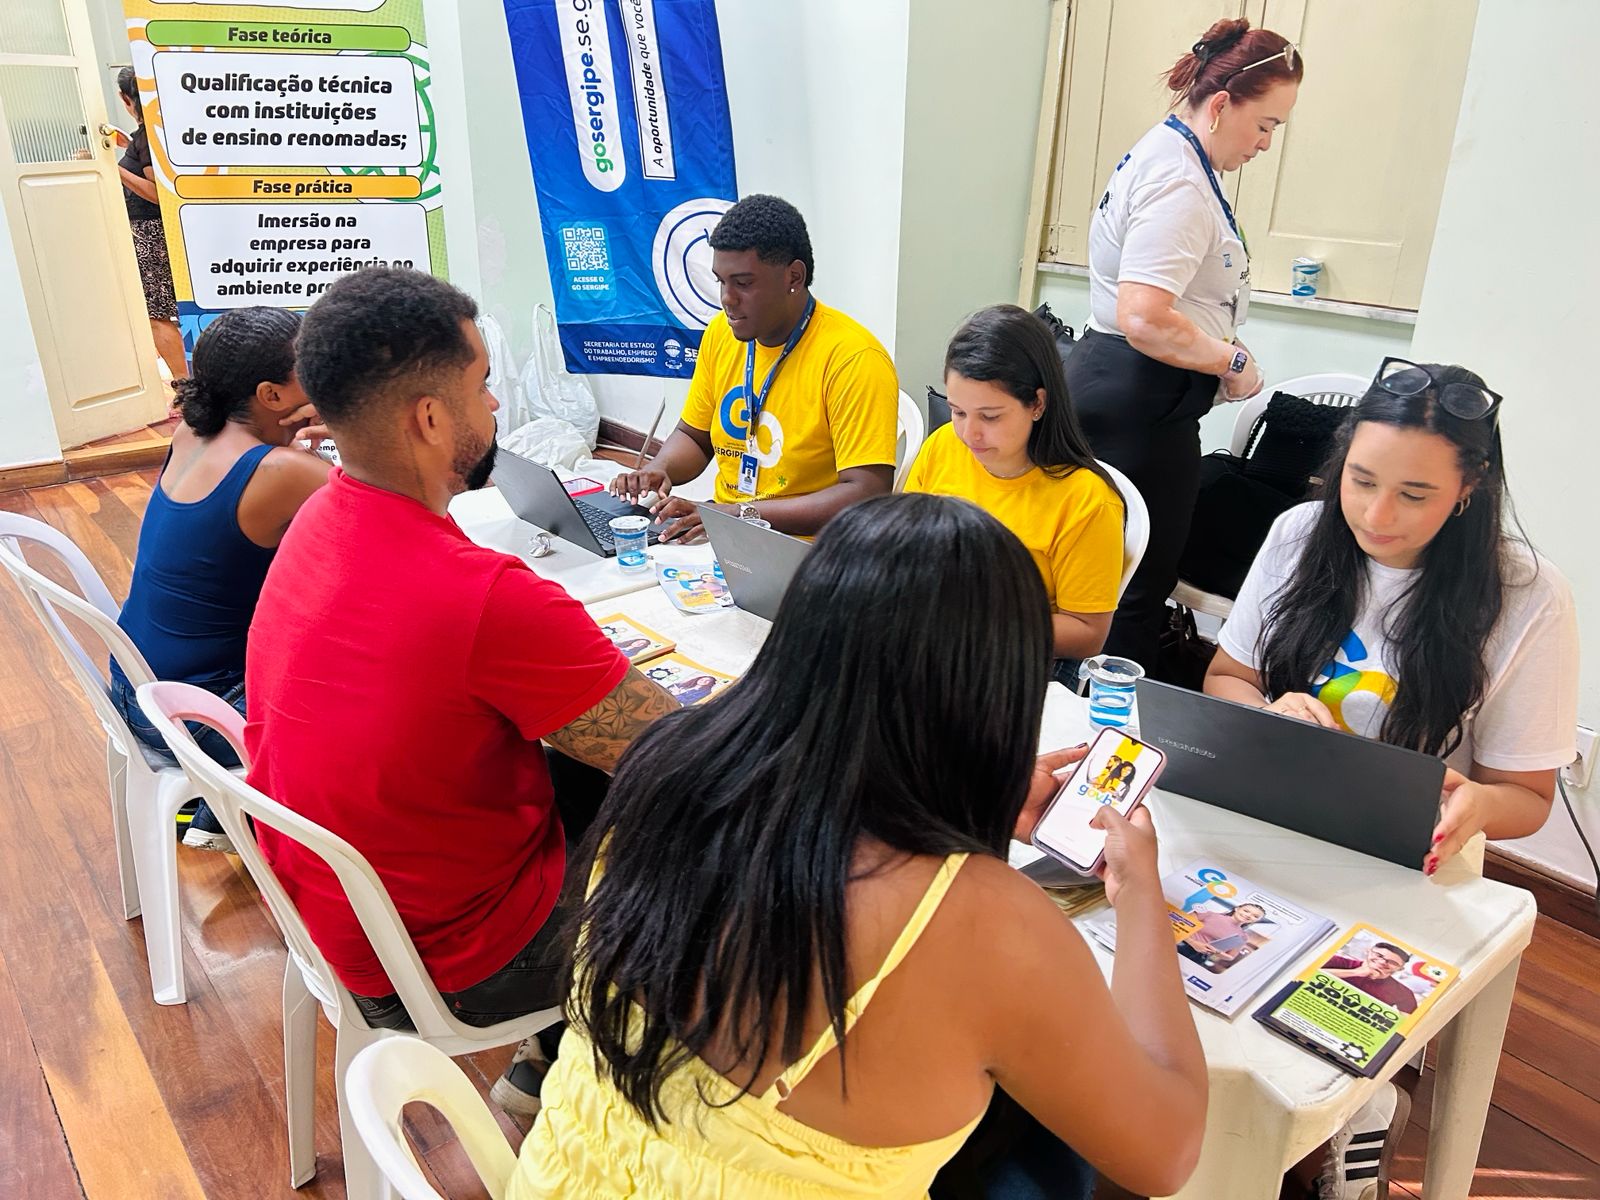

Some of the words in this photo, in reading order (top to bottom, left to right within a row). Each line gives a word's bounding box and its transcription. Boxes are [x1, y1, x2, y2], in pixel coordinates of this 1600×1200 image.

[228, 27, 268, 42] Fase
[272, 27, 332, 44] teórica
[637, 33, 651, 59] que
[181, 72, 313, 97] Qualificação
[319, 75, 392, 94] técnica
[206, 103, 249, 119] com
[255, 101, 376, 124] instituições
[641, 63, 663, 154] oportunidade
[182, 128, 208, 145] de
[212, 129, 283, 146] ensino
[287, 129, 407, 149] renomadas;
[653, 158, 664, 168] A
[253, 180, 292, 194] Fase
[295, 180, 353, 196] prática
[258, 213, 331, 228] Imersão
[335, 216, 357, 228] na
[250, 237, 327, 253] empresa
[331, 237, 371, 252] para
[210, 258, 284, 276] adquirir
[217, 280, 302, 295] ambiente
[306, 283, 332, 296] pro
[593, 356, 655, 364] EMPREENDEDORISMO
[1197, 868, 1238, 898] GO
[1309, 981, 1396, 1027] JOVEM
[1315, 974, 1361, 1005] GUIA
[1368, 1002, 1399, 1021] DO
[1304, 986, 1391, 1034] APRENDIZ
